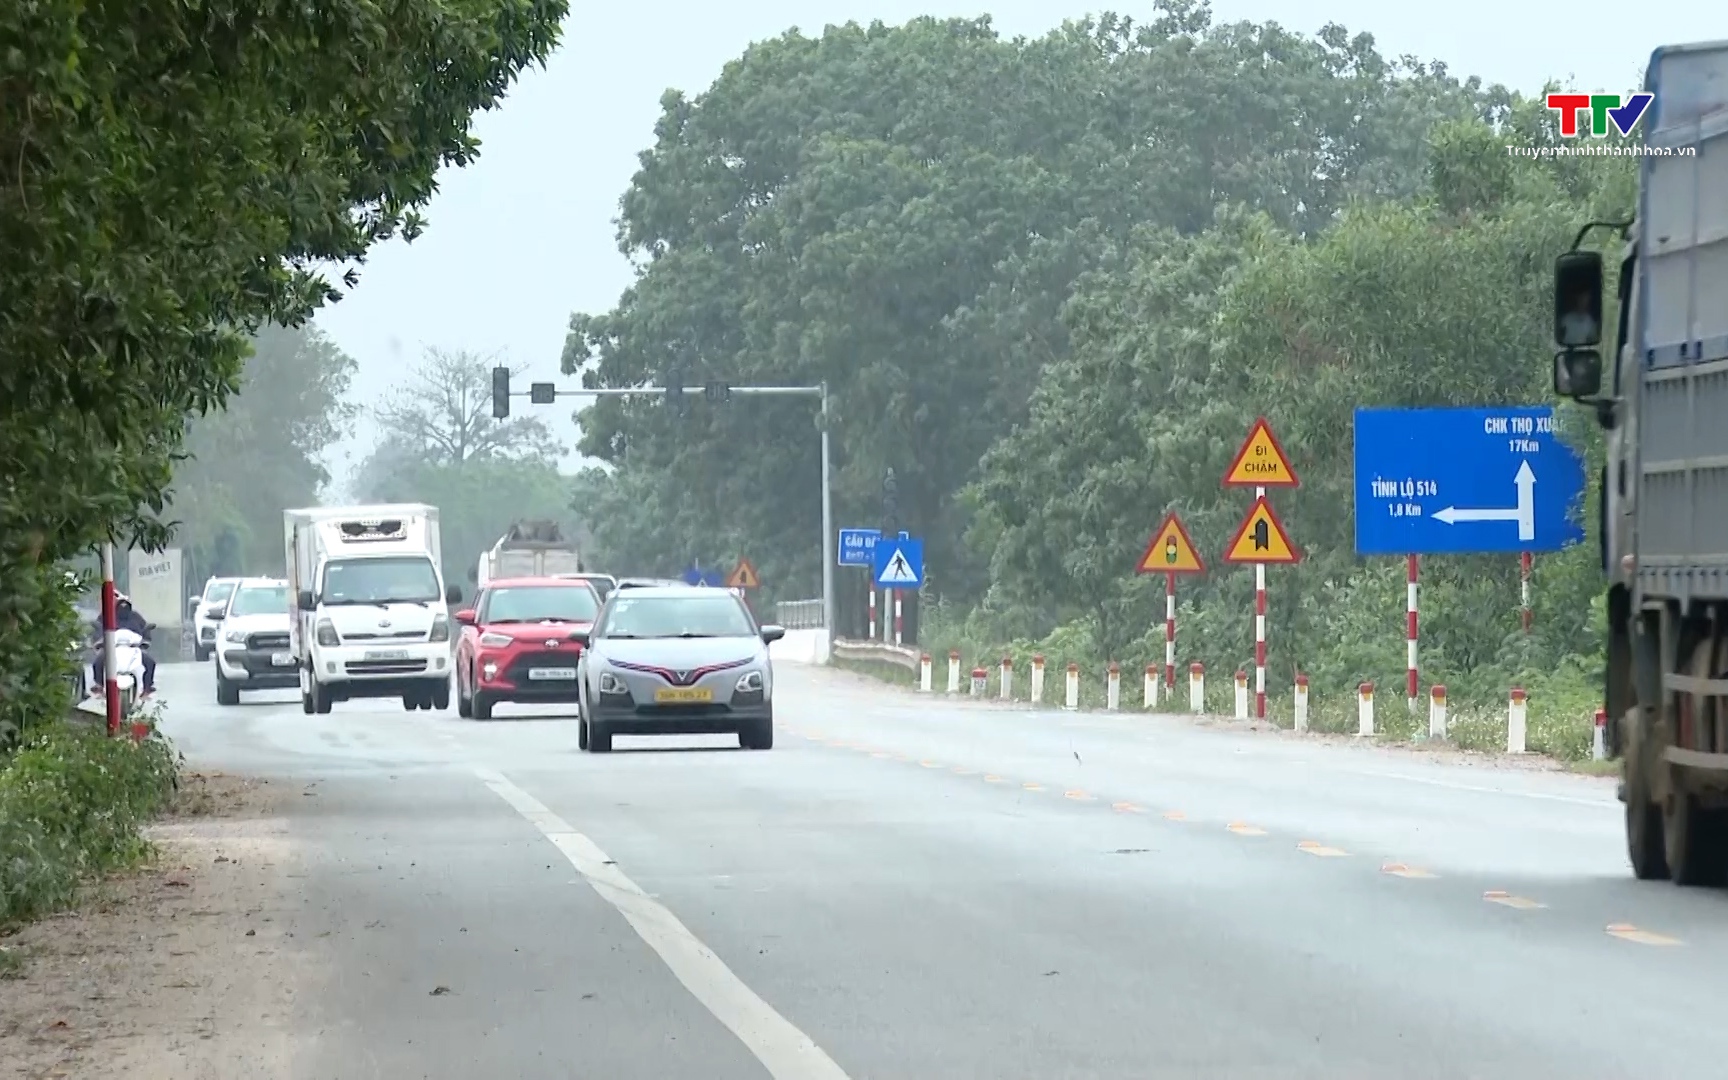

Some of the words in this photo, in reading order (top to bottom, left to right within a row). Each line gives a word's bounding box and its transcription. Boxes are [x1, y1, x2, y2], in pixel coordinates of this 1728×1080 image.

[1484, 417, 1508, 434] CHK
[1511, 417, 1533, 436] THỌ
[1255, 445, 1267, 456] ĐI
[1508, 439, 1539, 452] 17Km
[1400, 477, 1414, 499] LỘ
[1416, 479, 1437, 496] 514
[1405, 503, 1421, 516] Km
